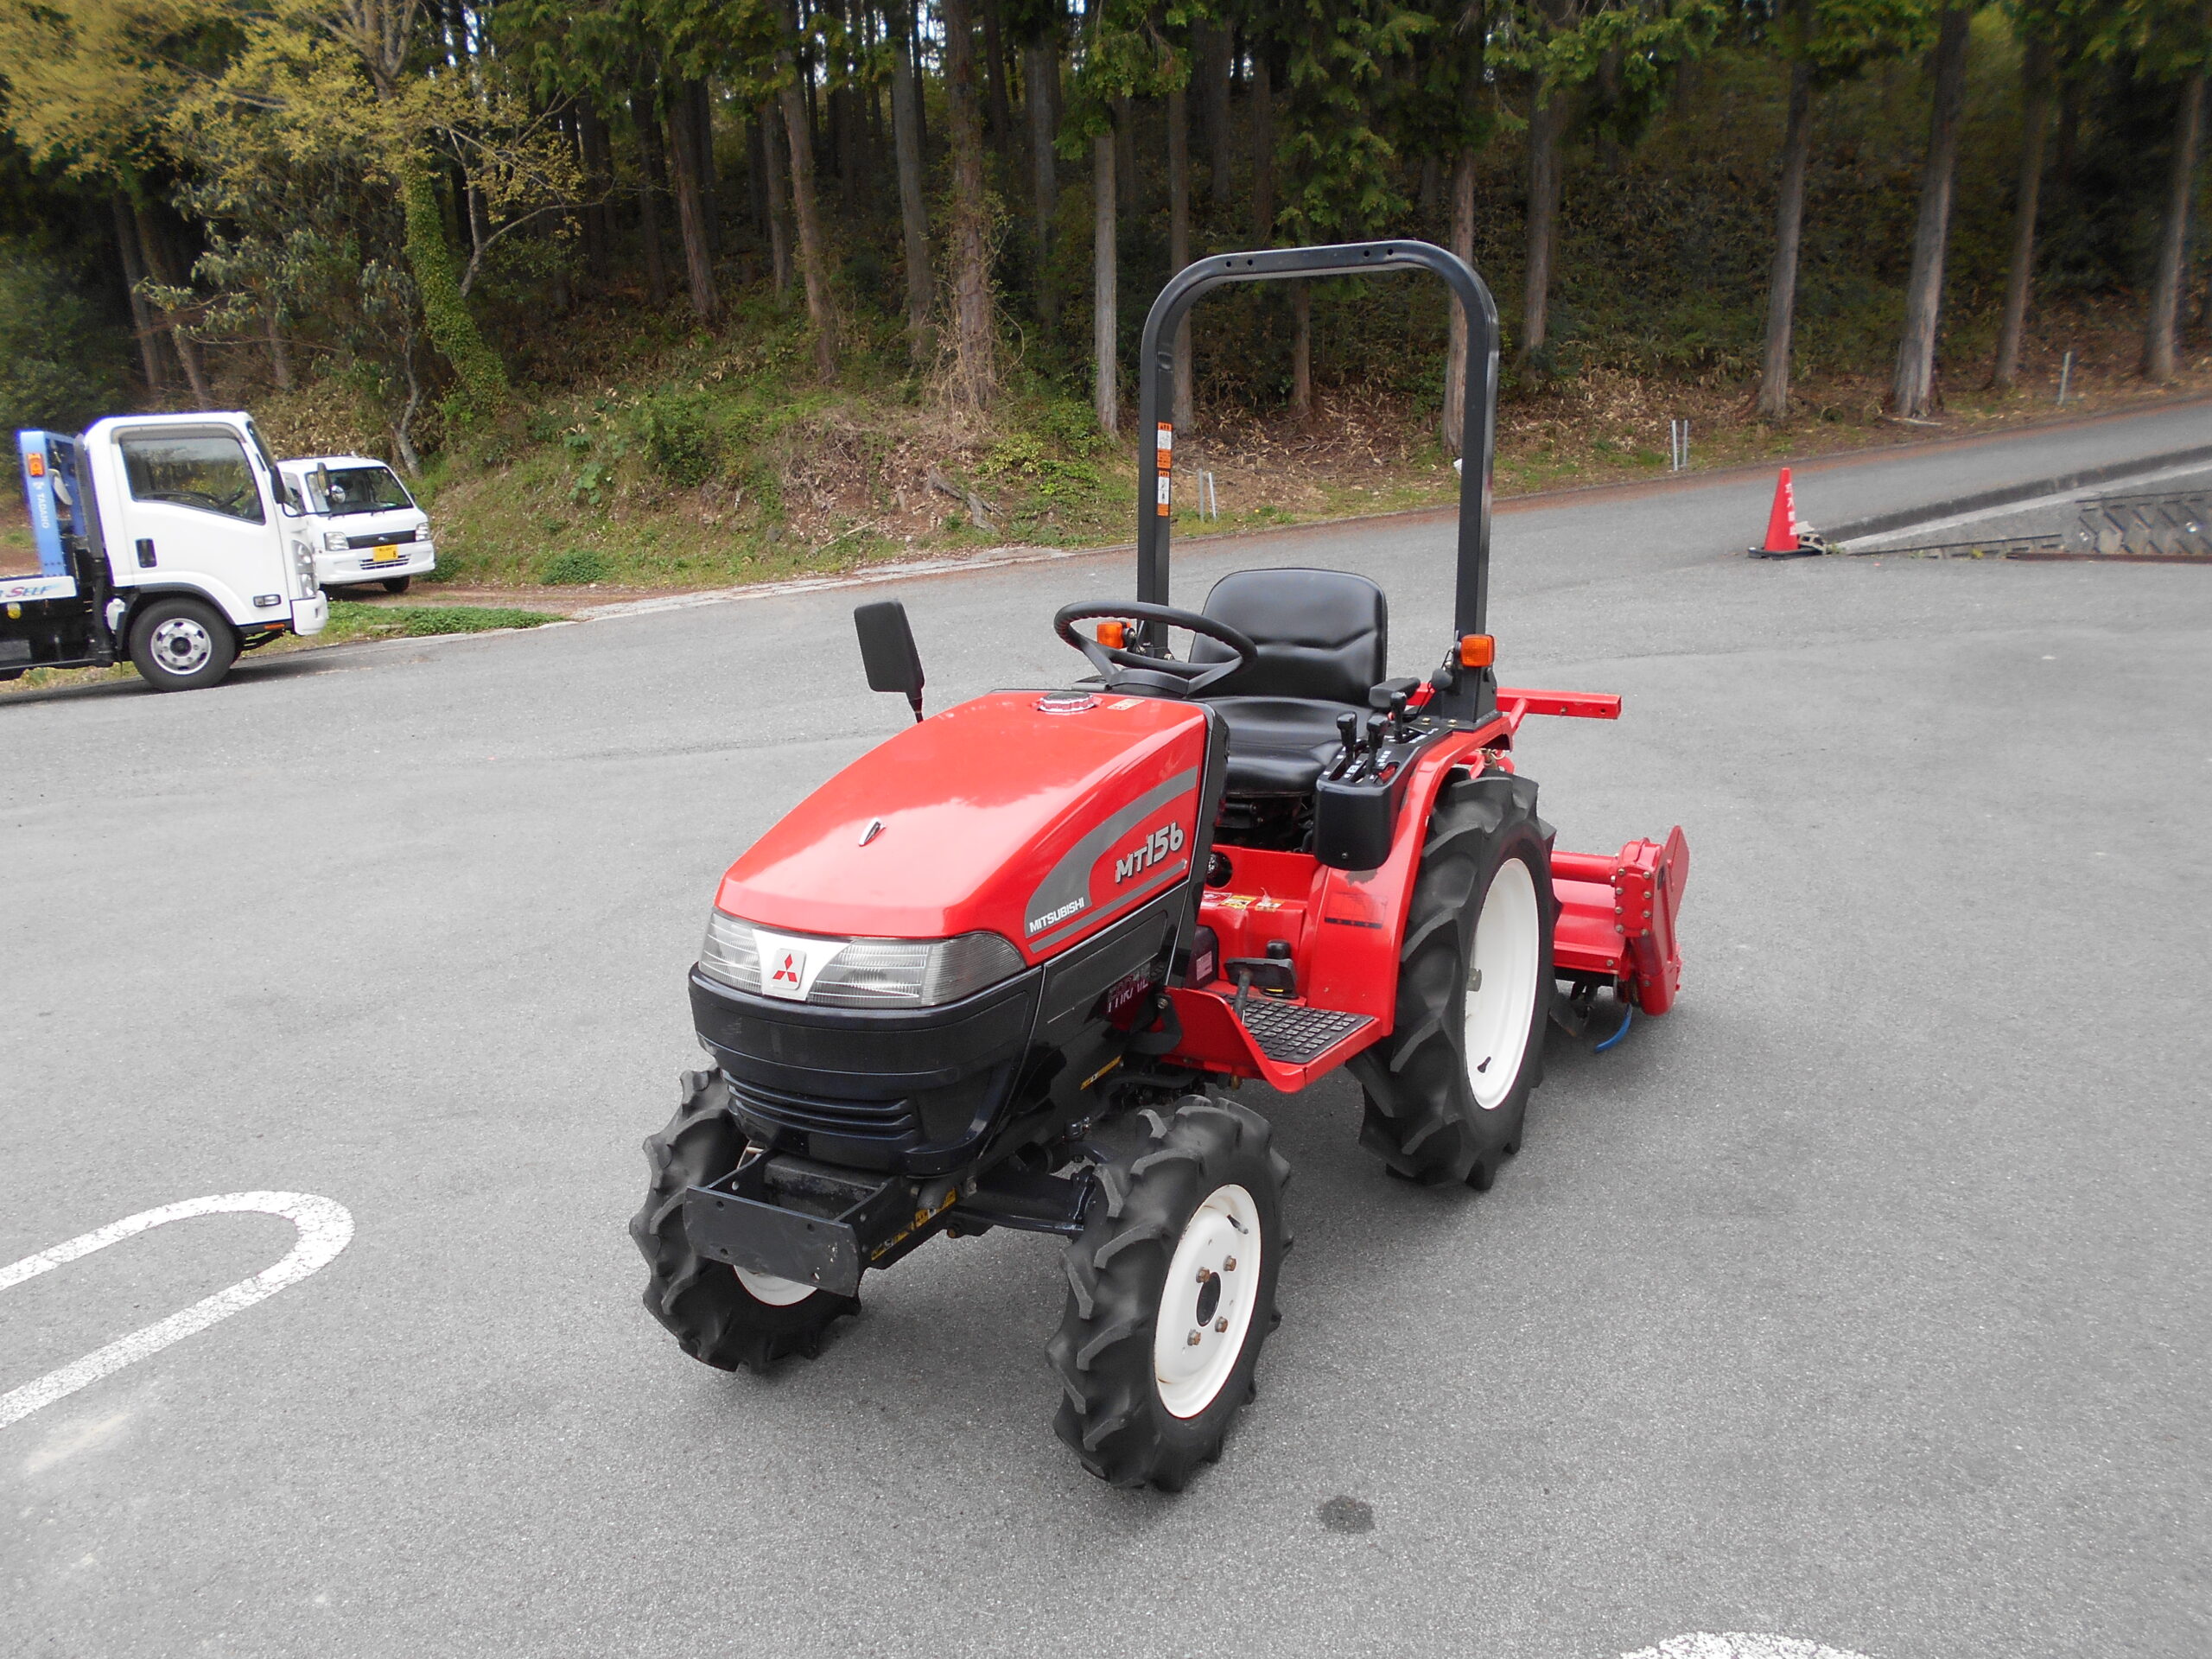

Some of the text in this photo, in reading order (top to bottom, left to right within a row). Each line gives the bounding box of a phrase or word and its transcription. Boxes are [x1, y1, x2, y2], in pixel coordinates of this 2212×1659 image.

[36, 493, 49, 528] TADANO
[5, 586, 49, 598] SELF
[1115, 822, 1185, 884] MT156
[1029, 897, 1085, 933] MITSUBISHI
